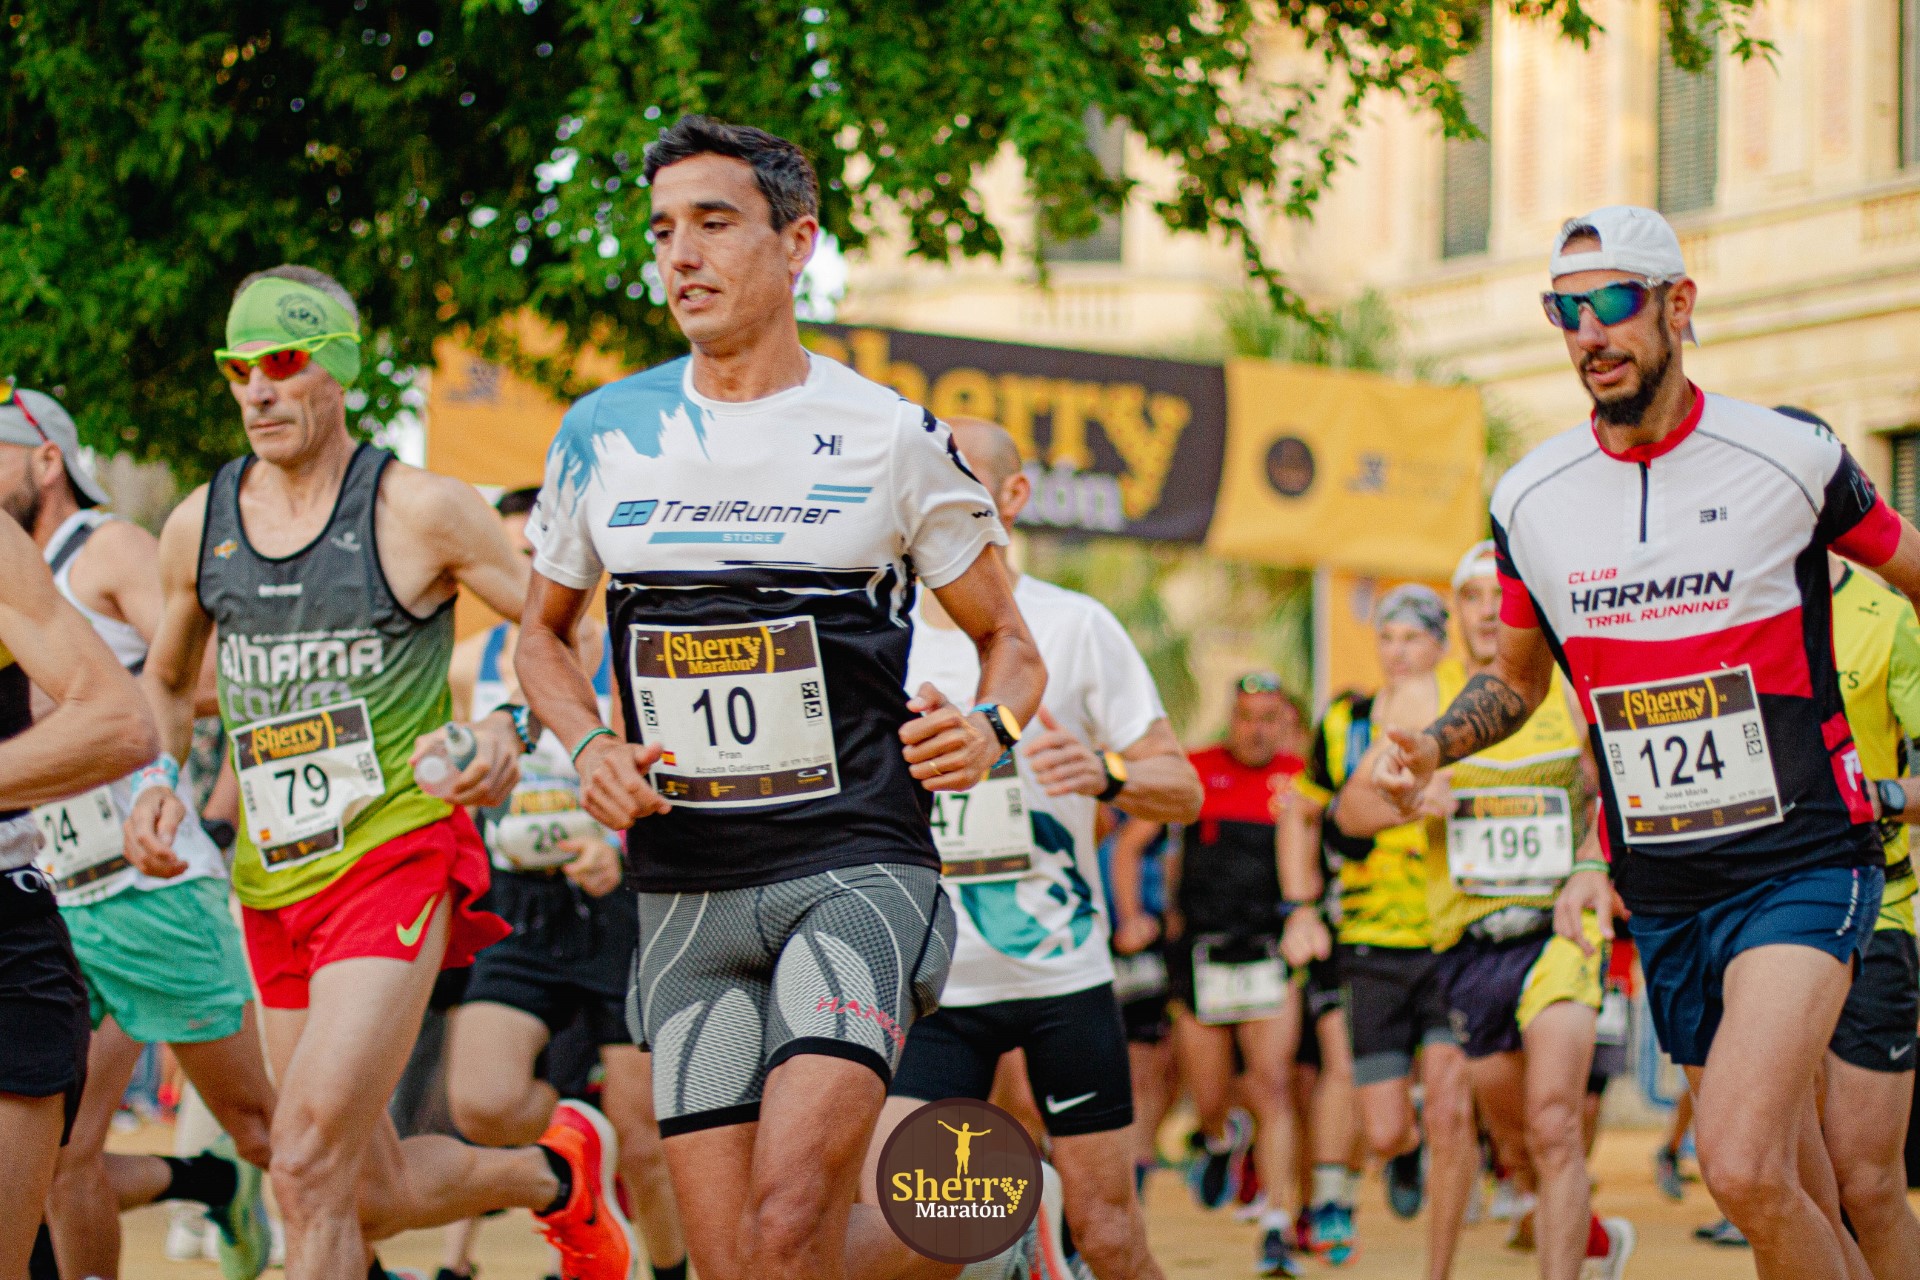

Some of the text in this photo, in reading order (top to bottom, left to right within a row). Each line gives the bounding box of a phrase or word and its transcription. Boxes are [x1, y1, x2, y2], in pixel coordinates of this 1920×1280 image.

[660, 500, 842, 525] TrailRunner
[722, 533, 777, 543] STORE
[1568, 567, 1618, 585] CLUB
[1570, 569, 1734, 614] HARMAN
[1585, 598, 1730, 629] TRAIL RUNNING
[671, 633, 763, 669] Sherry
[692, 686, 758, 747] 10
[1630, 686, 1707, 716] Sherry
[255, 719, 325, 752] Sherry
[719, 750, 743, 760] Fran
[1639, 729, 1726, 788] 124
[273, 763, 330, 816] 79
[1482, 825, 1542, 862] 196
